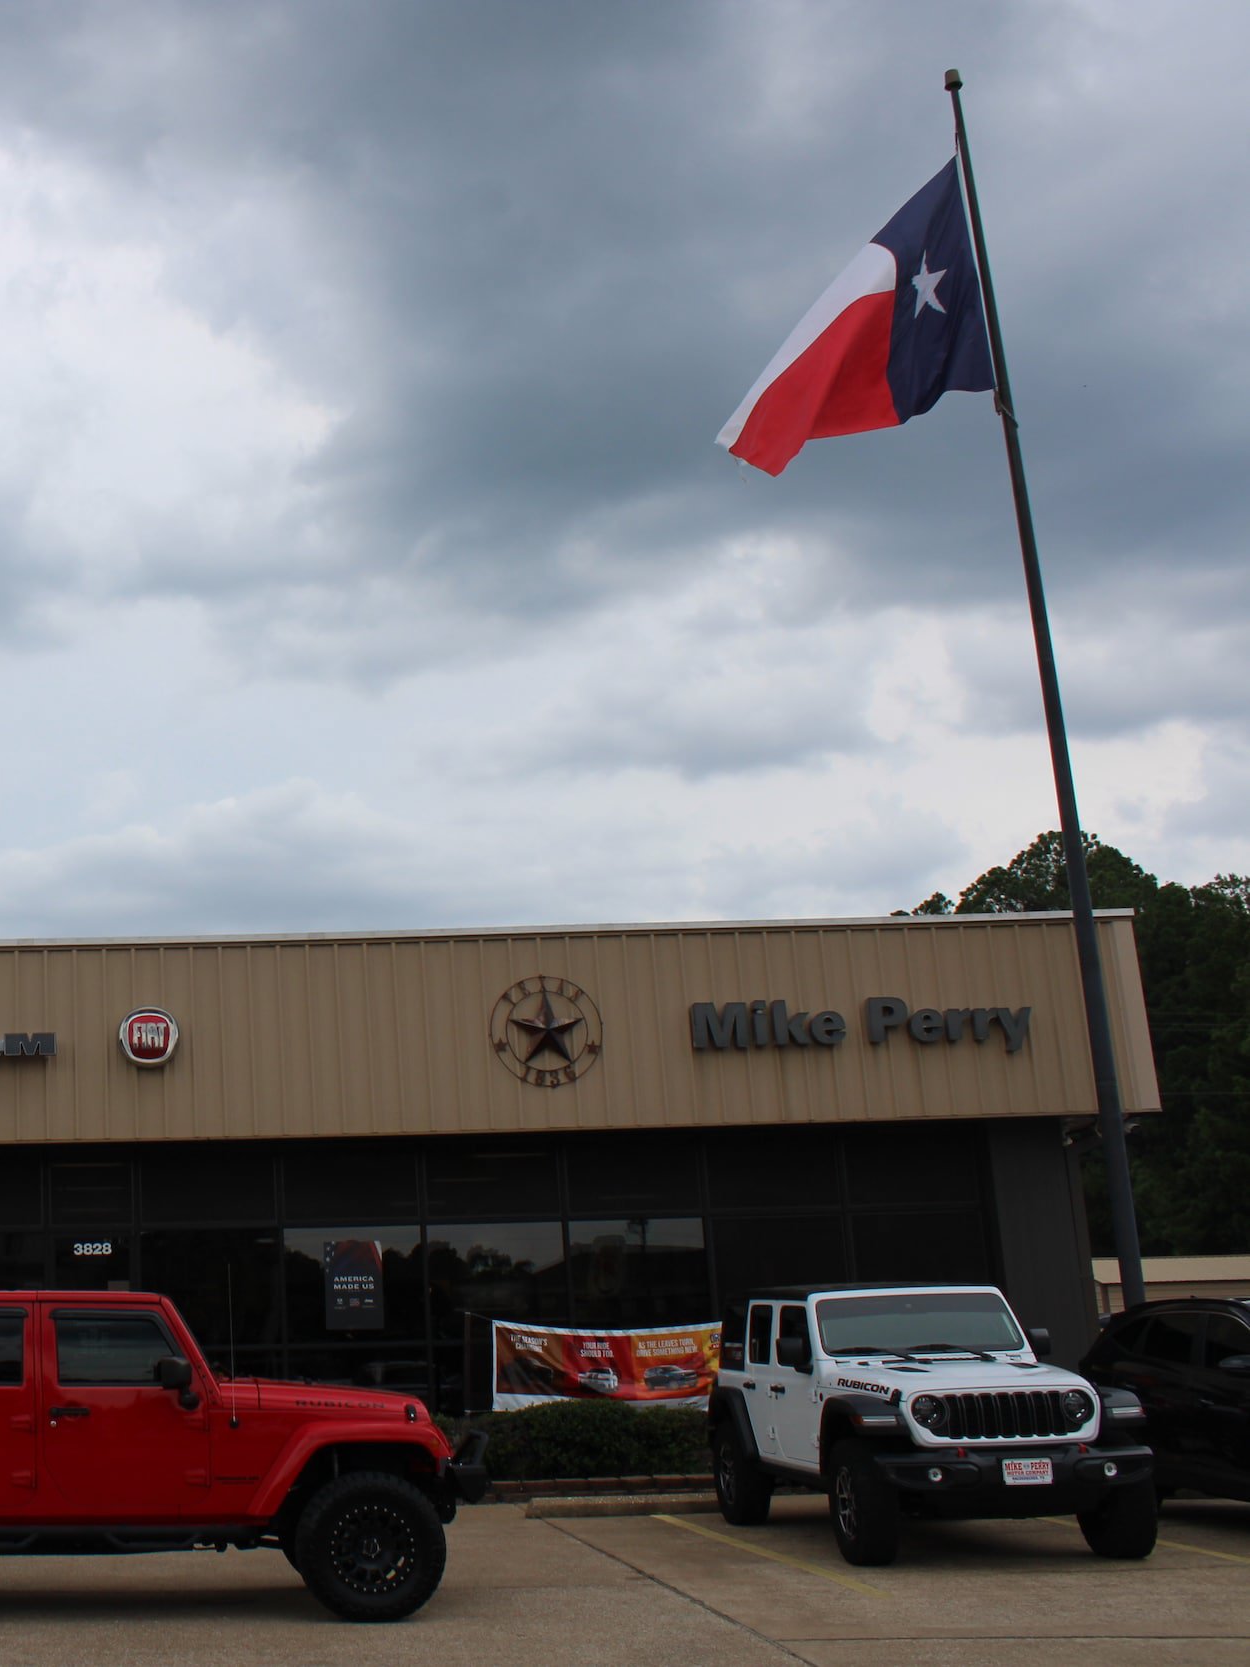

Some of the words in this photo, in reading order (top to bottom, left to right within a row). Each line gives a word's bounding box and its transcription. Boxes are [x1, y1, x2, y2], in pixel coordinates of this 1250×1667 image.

[689, 1000, 847, 1049] Mike
[866, 996, 1032, 1052] Perry
[132, 1021, 168, 1049] FIAT
[521, 1064, 577, 1089] 1836
[73, 1242, 113, 1256] 3828
[638, 1341, 647, 1349] AS
[658, 1339, 679, 1349] LEAVES
[837, 1377, 890, 1396] RUBICON
[295, 1400, 385, 1409] RUBICON
[1005, 1462, 1022, 1471] MIKE
[1030, 1462, 1049, 1470] PERRY
